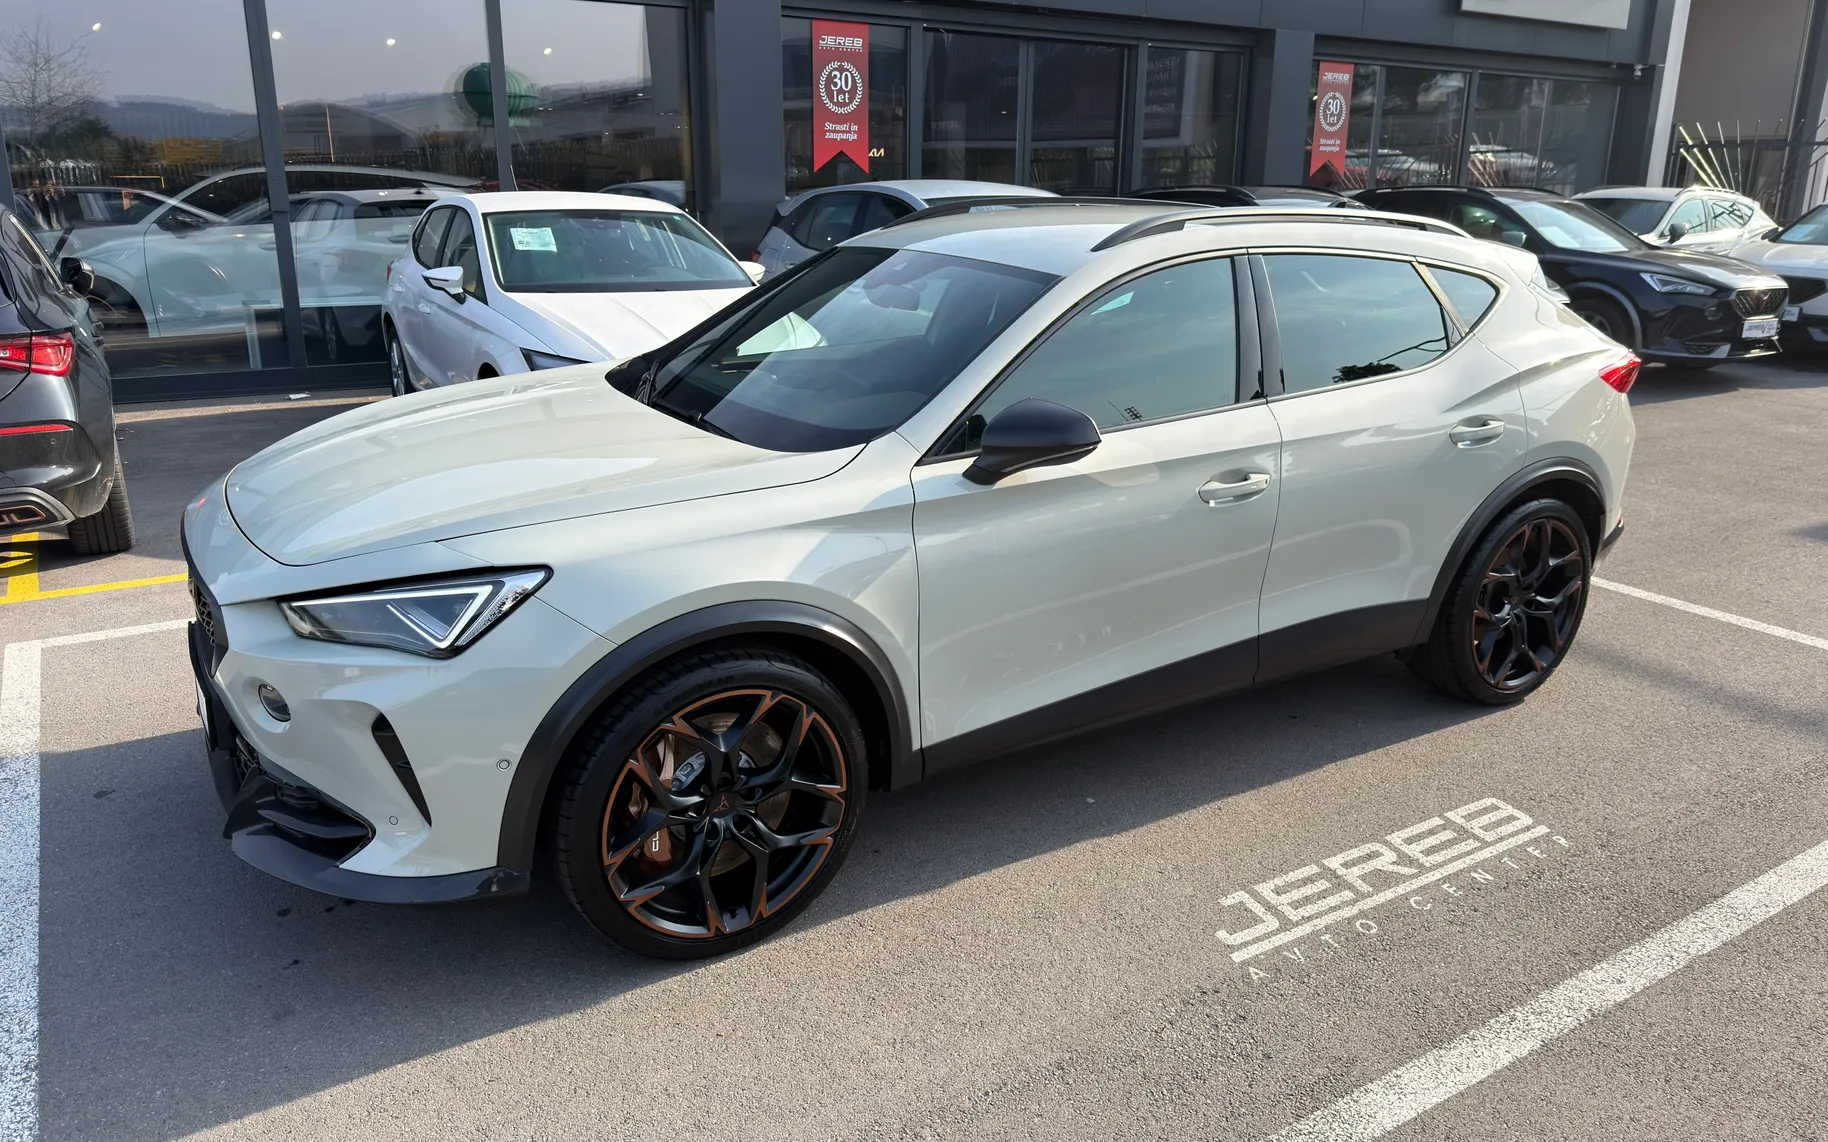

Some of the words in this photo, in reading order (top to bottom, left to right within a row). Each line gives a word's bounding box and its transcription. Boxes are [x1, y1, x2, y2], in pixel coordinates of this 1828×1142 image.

[819, 35, 863, 47] JEREB
[830, 71, 852, 91] 30
[833, 90, 850, 103] let
[1326, 99, 1340, 114] 30
[1327, 113, 1337, 123] let
[824, 122, 850, 131] Strasti
[850, 122, 858, 131] in
[825, 131, 857, 141] zaupanja
[1214, 797, 1535, 946] JEREB
[1249, 919, 1378, 981] AVTO
[1409, 834, 1574, 910] CENTER
